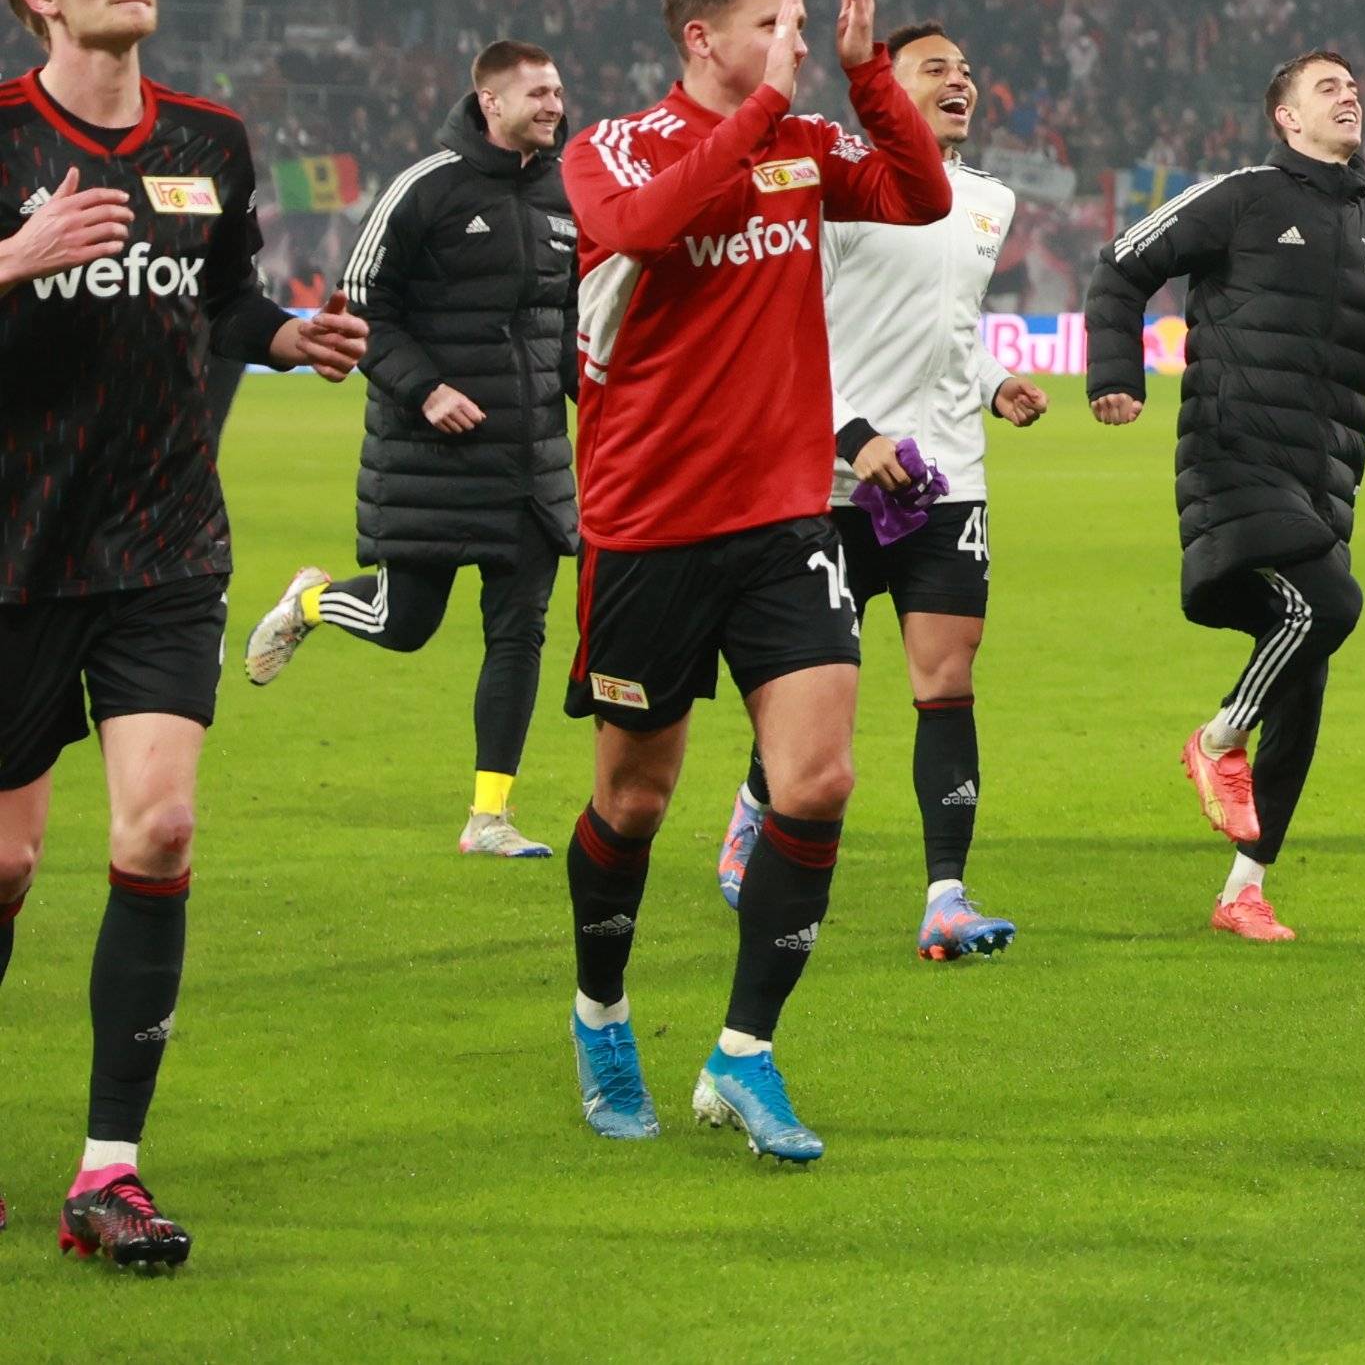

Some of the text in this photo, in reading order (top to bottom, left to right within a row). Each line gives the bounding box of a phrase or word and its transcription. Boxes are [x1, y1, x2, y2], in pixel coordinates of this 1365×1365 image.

[685, 216, 812, 267] wefox
[33, 242, 204, 300] wefox
[989, 318, 1087, 373] Bull
